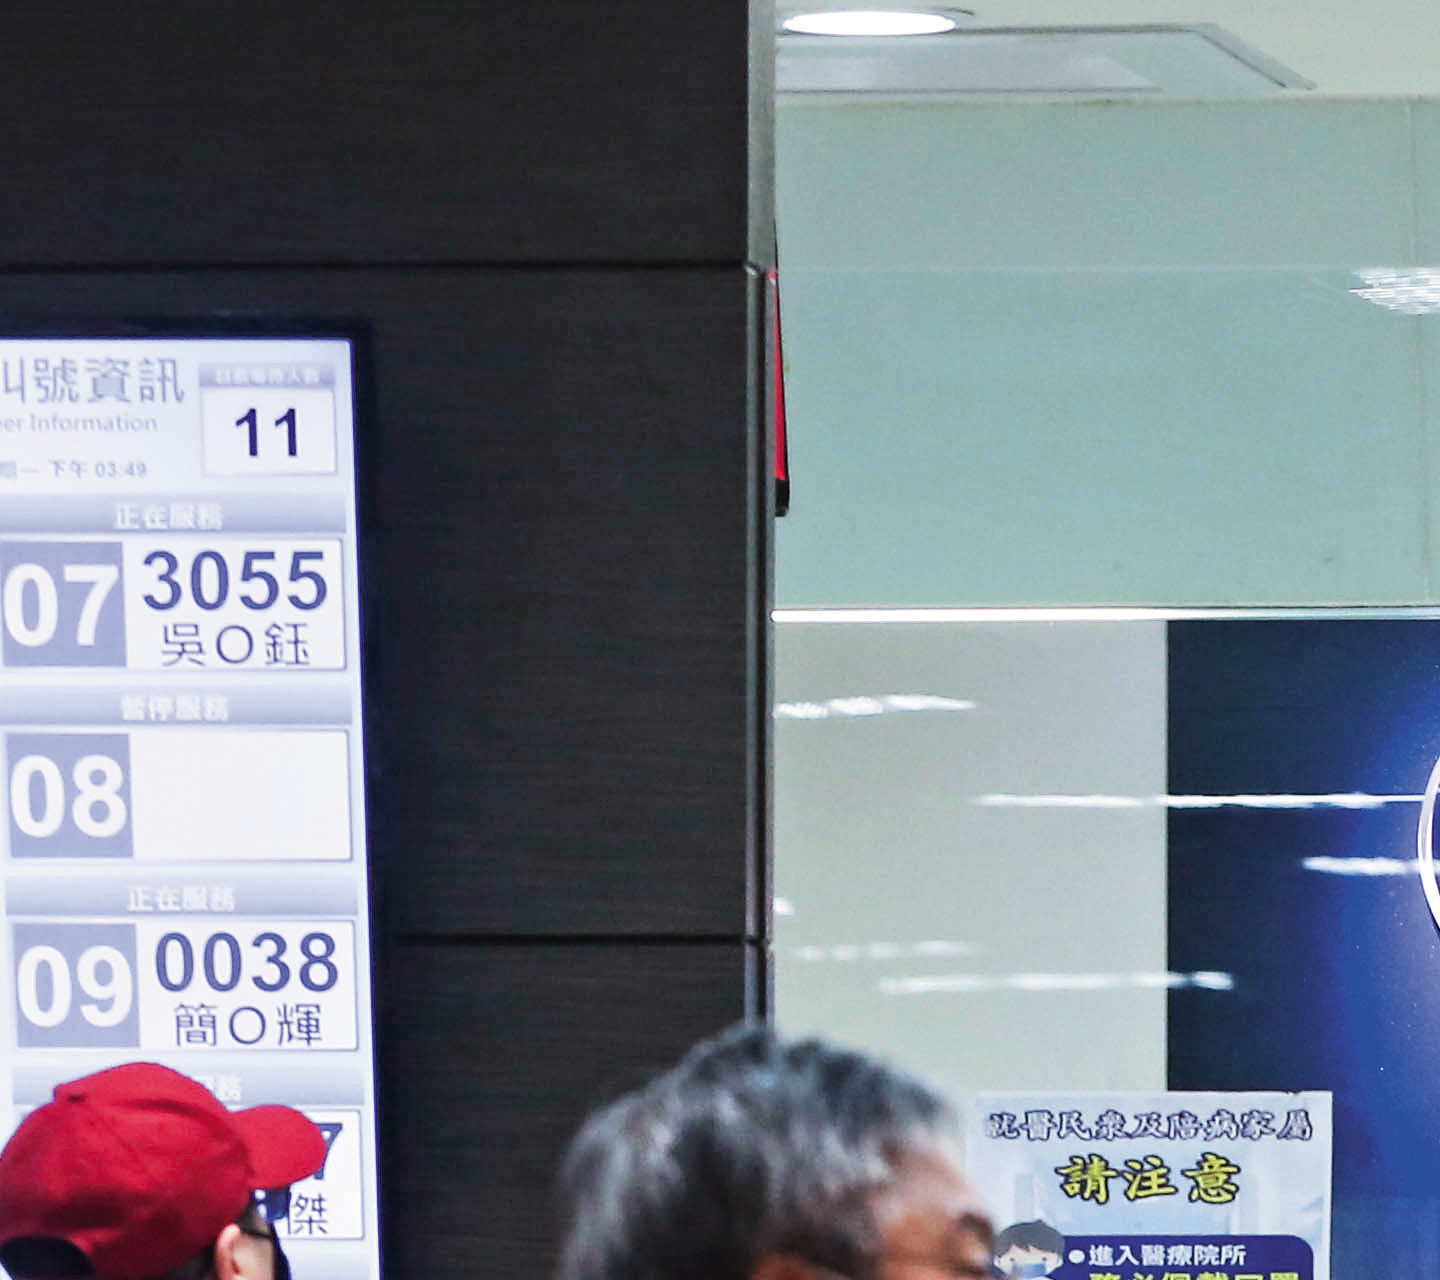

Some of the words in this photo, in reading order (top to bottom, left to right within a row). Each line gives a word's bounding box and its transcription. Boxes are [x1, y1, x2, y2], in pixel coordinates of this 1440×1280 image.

[30, 414, 158, 432] Information
[235, 408, 298, 457] 11
[113, 502, 224, 531] 正在服務
[3, 563, 121, 647] 07
[142, 549, 329, 611] 3055
[10, 753, 128, 838] 08
[17, 944, 132, 1028] 09
[154, 930, 340, 993] 0038
[1055, 1152, 1242, 1205] 請注意
[1088, 1244, 1247, 1267] 進入醫療院所
